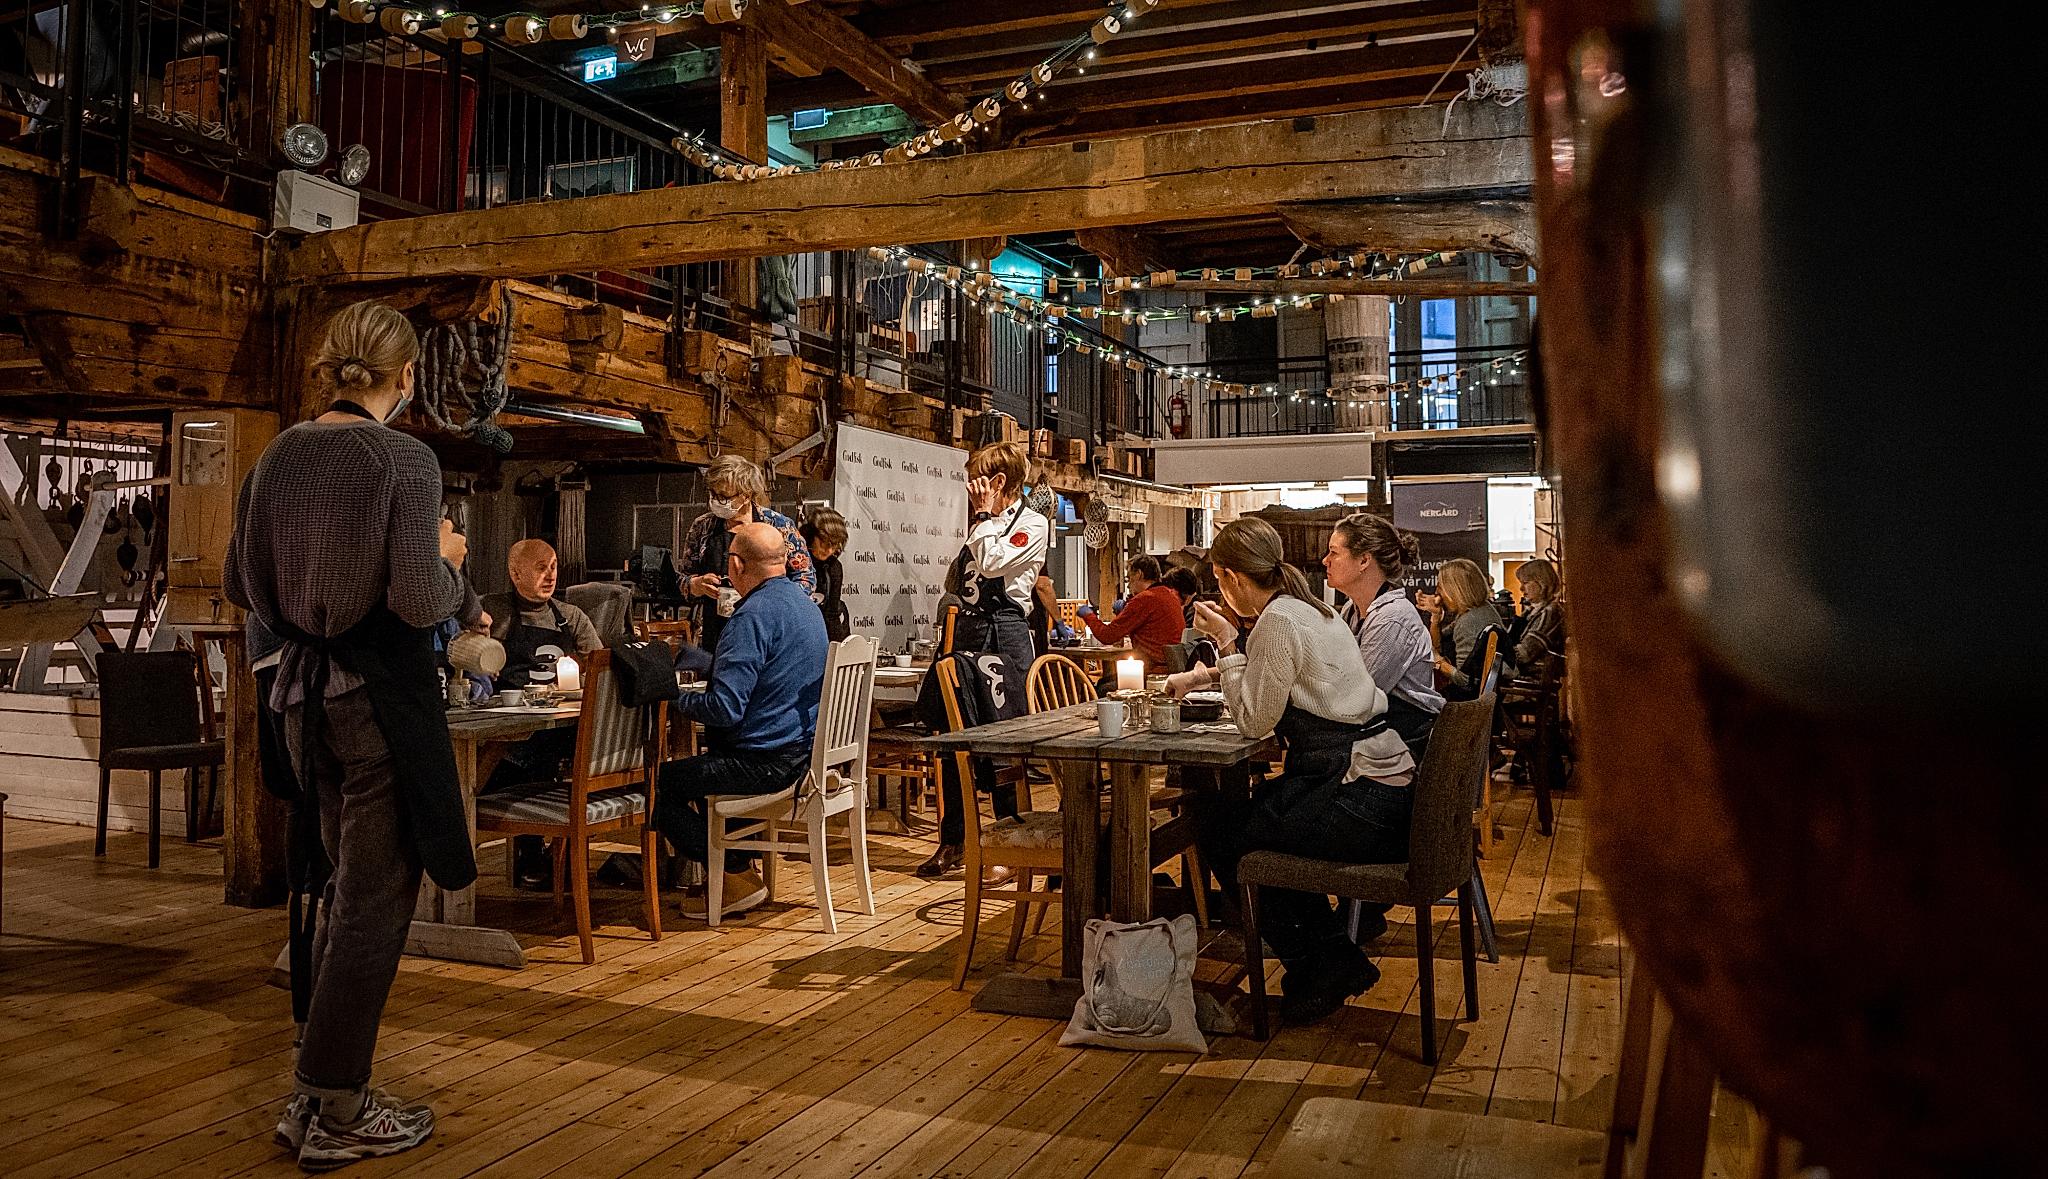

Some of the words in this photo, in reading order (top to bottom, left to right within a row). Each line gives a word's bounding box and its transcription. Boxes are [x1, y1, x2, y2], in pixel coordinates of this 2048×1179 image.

[625, 38, 649, 53] WC
[842, 449, 863, 464] Godfisk
[872, 456, 893, 470] Godfisk
[901, 460, 919, 474] Godfisk
[926, 466, 943, 479] Godfisk
[856, 485, 877, 499] Godfisk
[886, 489, 906, 503] Godfisk
[1420, 509, 1458, 517] NERGÅRD
[872, 519, 891, 533] Godfisk
[900, 522, 919, 535] Godfisk
[854, 550, 876, 564] Godfisk
[886, 552, 905, 566] Godfisk
[913, 554, 931, 566] Godfisk
[1401, 574, 1421, 587] vår
[870, 583, 891, 597] Godfisk
[899, 583, 918, 597] Godfisk
[853, 615, 875, 629] Godfisk
[884, 615, 905, 628] Godfisk
[912, 614, 930, 626] Godfisk
